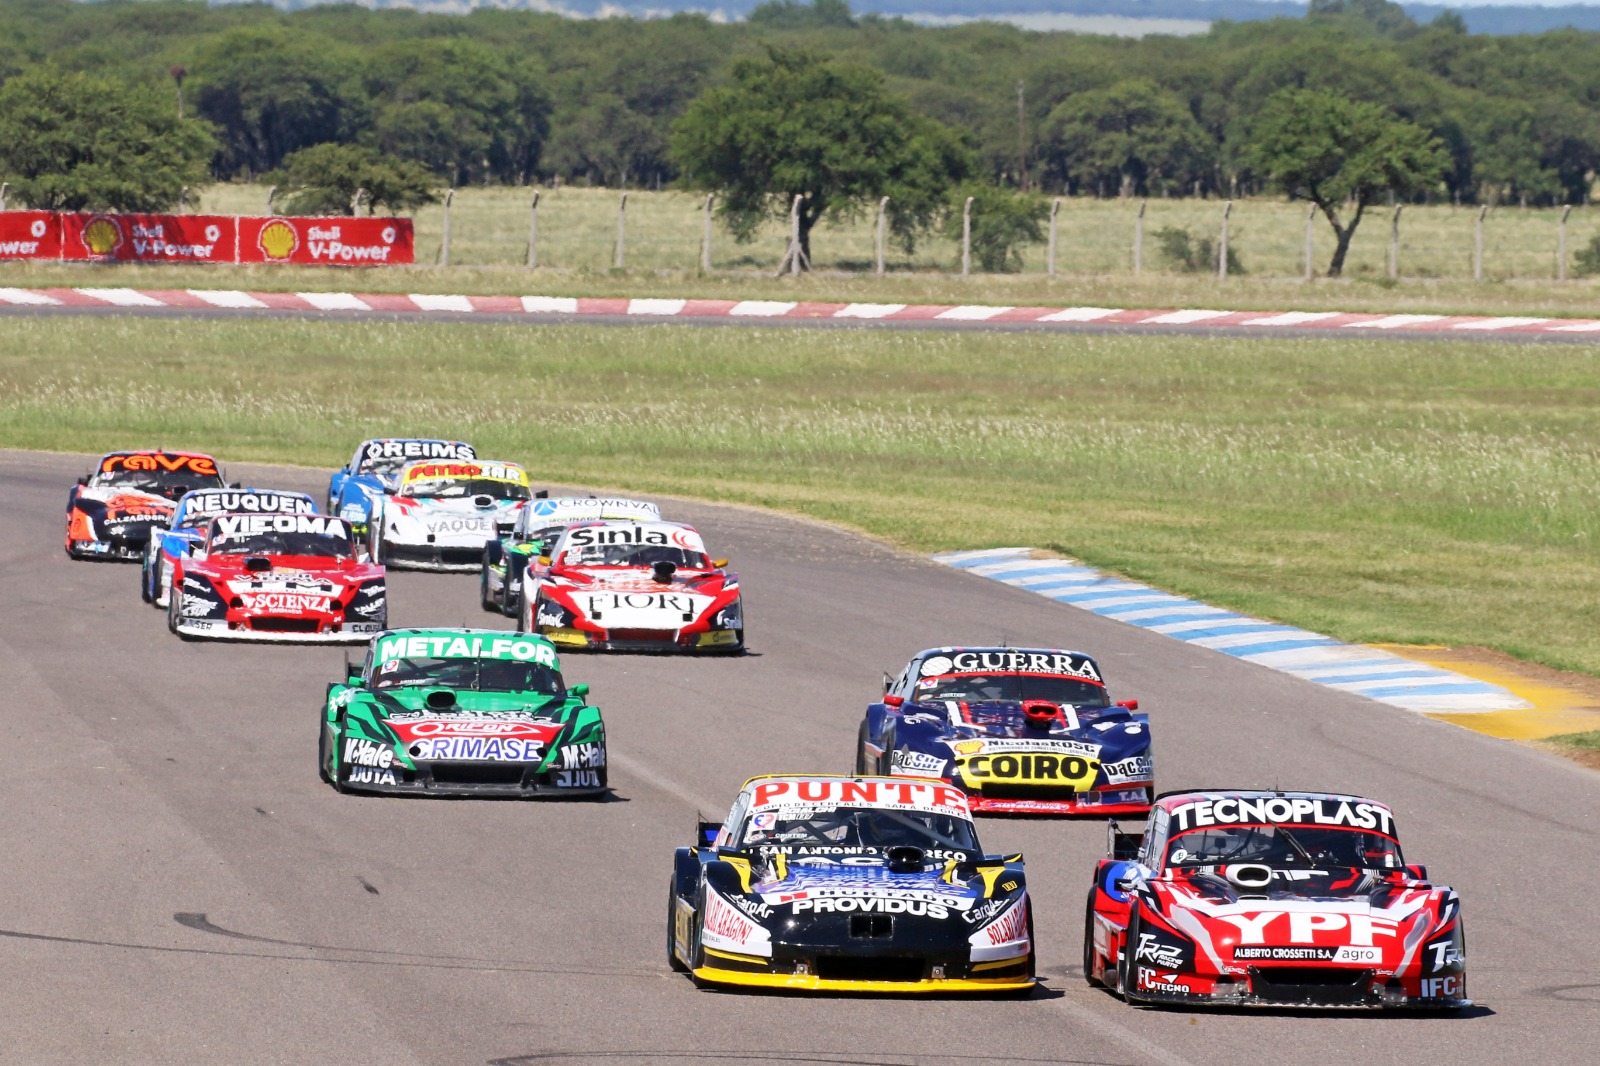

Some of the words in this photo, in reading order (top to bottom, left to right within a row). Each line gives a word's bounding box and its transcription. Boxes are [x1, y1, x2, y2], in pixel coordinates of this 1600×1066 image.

[132, 223, 163, 238] Shell
[308, 226, 341, 240] Shell
[132, 238, 214, 258] V-Power
[308, 241, 391, 260] V-Power
[383, 442, 474, 461] REIMS
[102, 454, 218, 475] rave
[409, 464, 521, 481] PETROSAR
[186, 493, 316, 515] NEUQUEN
[427, 519, 495, 533] VAQUE
[571, 527, 668, 547] Sinla
[255, 593, 334, 615] SCIENZA
[587, 593, 698, 615] FIORI
[380, 636, 556, 668] METALFOR
[953, 652, 1100, 680] GUERRA
[410, 738, 542, 761] CRIMASE
[968, 755, 1089, 780] COIRO
[753, 781, 967, 814] PUNTE
[807, 800, 873, 808] CEREALES
[1171, 798, 1394, 835] TECNOPLAST
[923, 850, 967, 863] RECO
[791, 897, 950, 920] PROVIDUS
[1215, 911, 1399, 946] YPF
[1234, 948, 1271, 959] ALBERTO
[1273, 948, 1316, 960] CROSSETTI
[1317, 949, 1333, 960] S.A.
[1342, 949, 1375, 961] agro
[1155, 981, 1190, 993] TECNO
